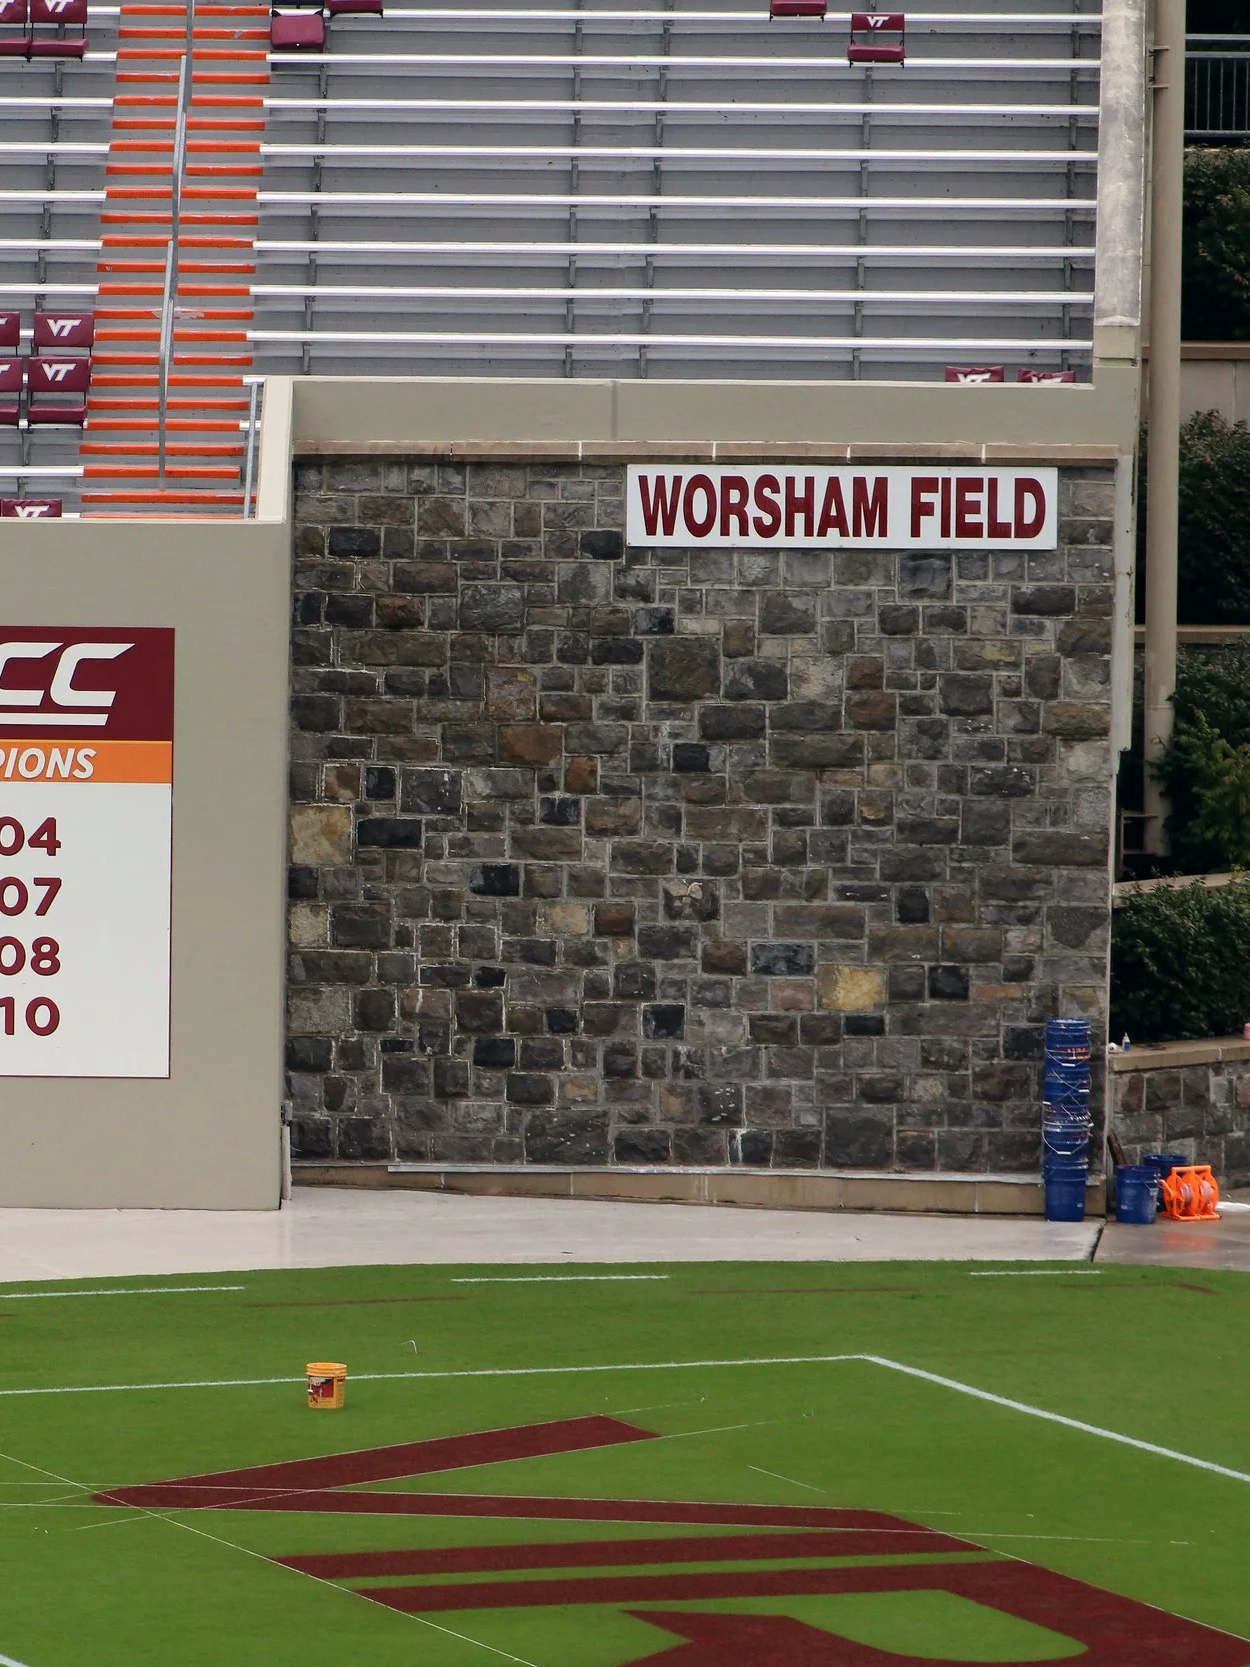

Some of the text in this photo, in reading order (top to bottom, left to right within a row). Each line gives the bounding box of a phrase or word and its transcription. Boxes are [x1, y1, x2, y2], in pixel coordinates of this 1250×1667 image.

[867, 16, 890, 27] VT
[47, 318, 82, 336] VT
[41, 363, 77, 381] VT
[638, 474, 1047, 539] WORSHAM FIELD
